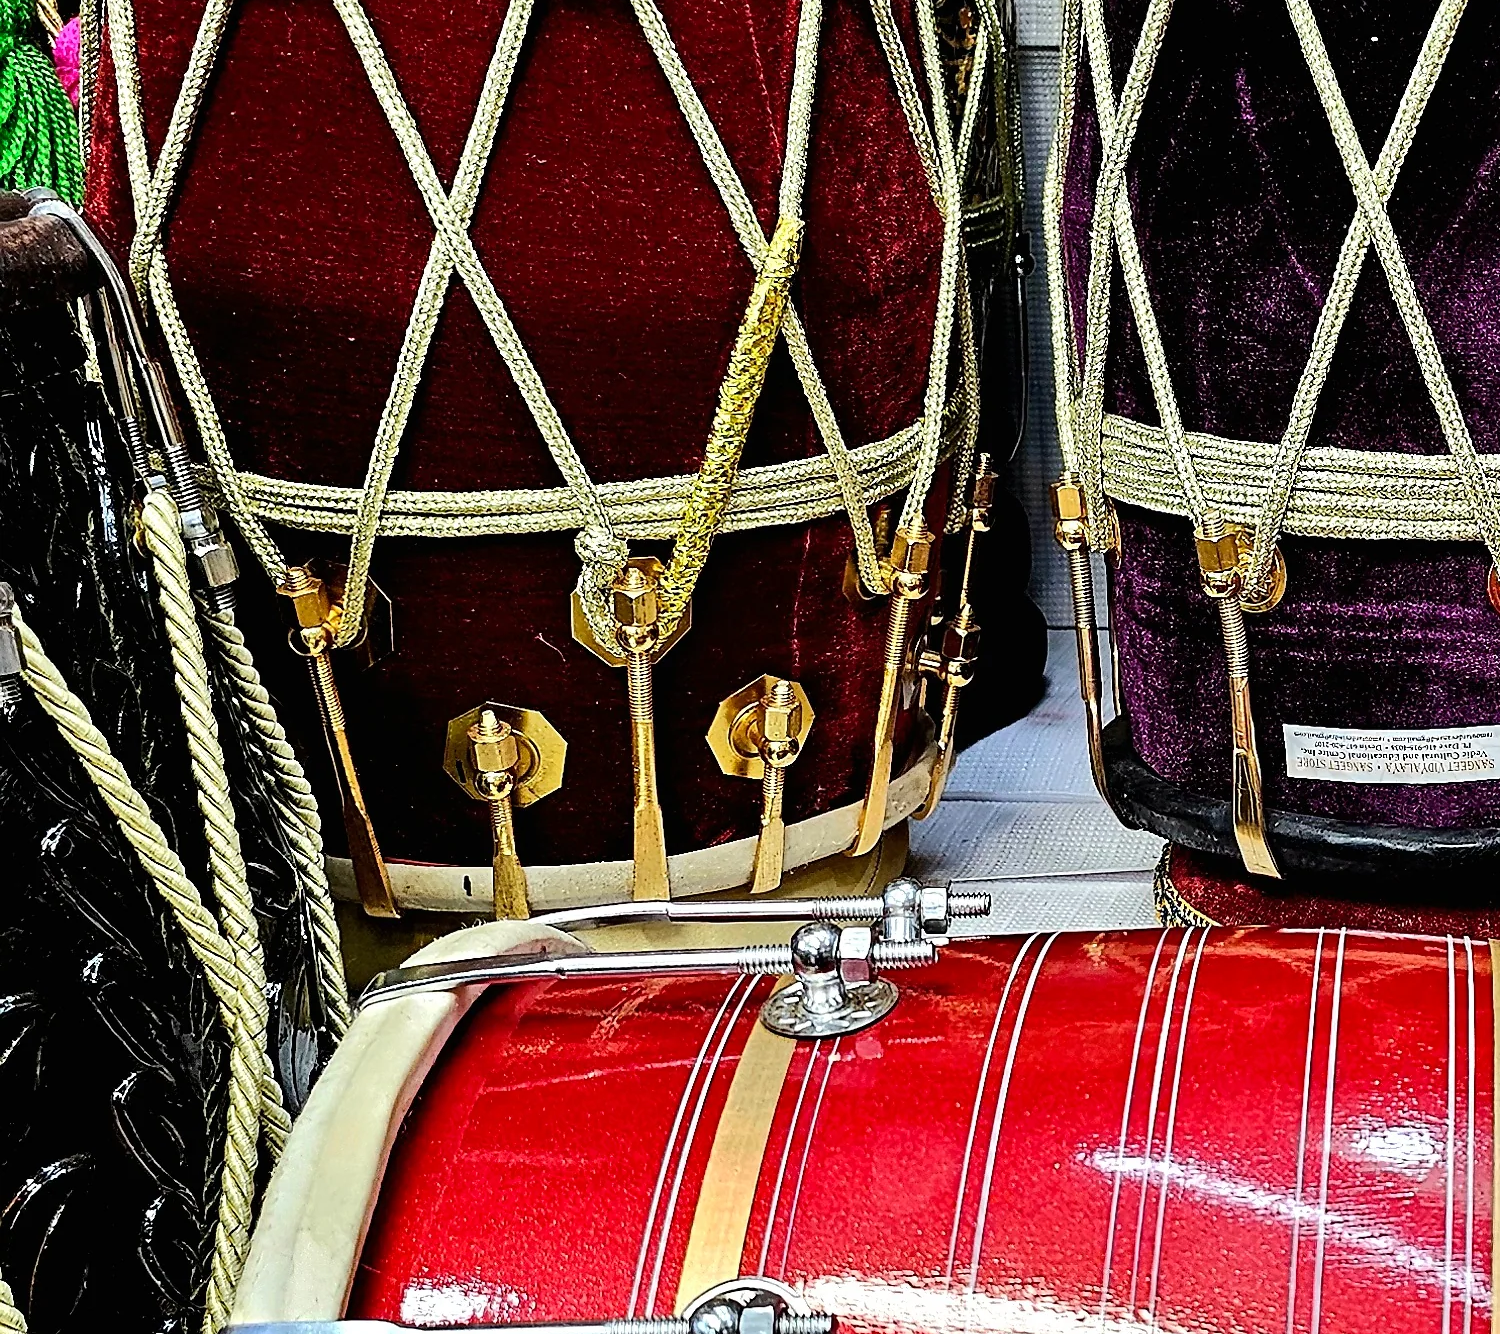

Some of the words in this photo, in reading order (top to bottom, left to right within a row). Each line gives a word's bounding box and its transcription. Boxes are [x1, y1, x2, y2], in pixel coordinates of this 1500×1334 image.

[1439, 742, 1459, 750] Dave
[1300, 747, 1316, 757] Inc.
[1317, 749, 1346, 759] Centre
[1349, 752, 1400, 761] Educational
[1402, 753, 1419, 761] and
[1421, 751, 1460, 761] Cultural
[1462, 750, 1488, 759] Vedic
[1297, 756, 1327, 769] STORE
[1328, 760, 1374, 772] SANGEET
[1447, 758, 1495, 772] SANGEET
[1385, 762, 1445, 774] VIDYALAYA
